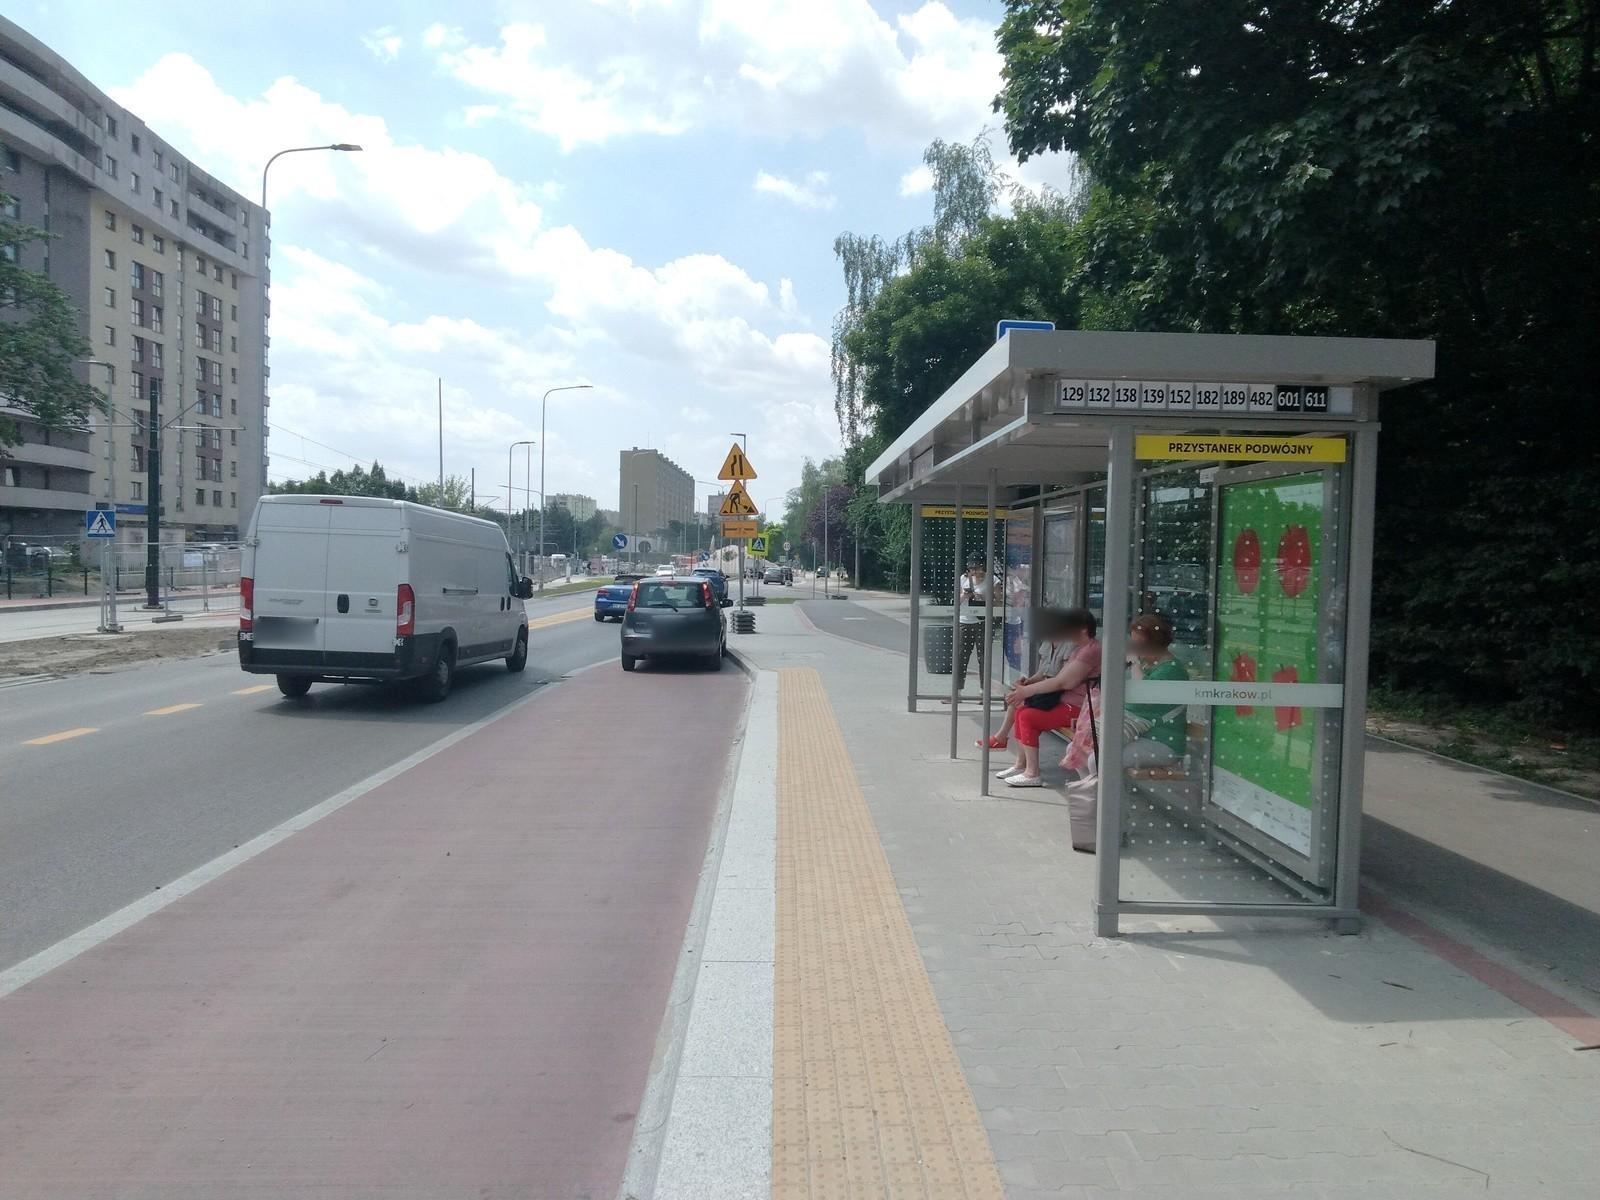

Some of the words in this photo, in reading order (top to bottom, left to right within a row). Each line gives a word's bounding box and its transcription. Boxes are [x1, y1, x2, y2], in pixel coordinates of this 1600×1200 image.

[1062, 387, 1083, 401] 129
[1089, 389, 1110, 402] 132
[1116, 389, 1136, 403] 138
[1143, 390, 1164, 403] 139
[1170, 390, 1191, 404] 152
[1197, 391, 1218, 404] 182
[1224, 391, 1244, 405] 189
[1250, 392, 1272, 406] 482
[1278, 393, 1299, 406] 601
[1305, 394, 1326, 407] 611
[1169, 443, 1242, 454] PRZYSTANEK
[1245, 442, 1314, 455] PODWÓJNY
[1195, 688, 1272, 700] kmkrakow.pl
